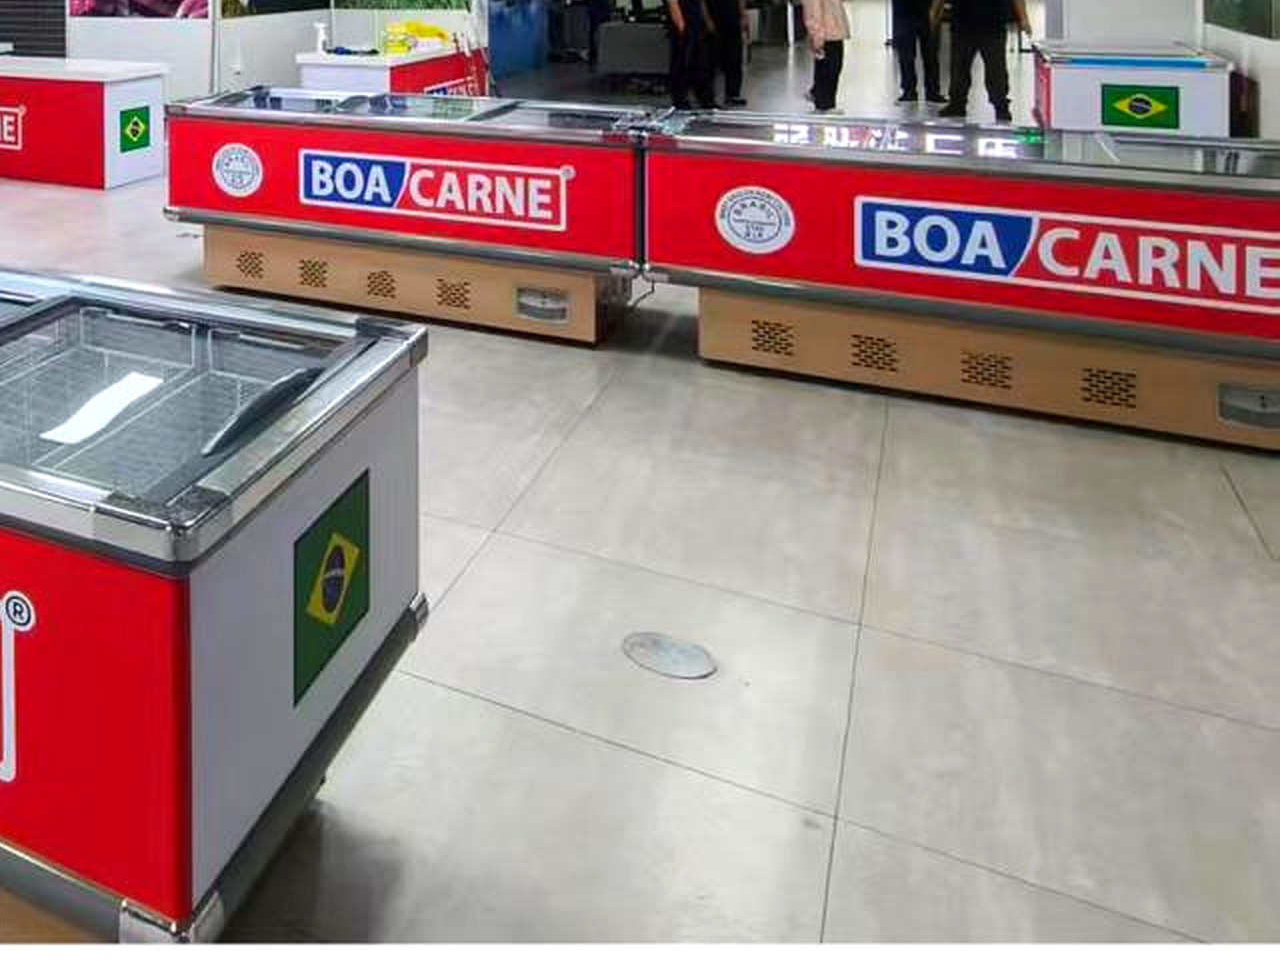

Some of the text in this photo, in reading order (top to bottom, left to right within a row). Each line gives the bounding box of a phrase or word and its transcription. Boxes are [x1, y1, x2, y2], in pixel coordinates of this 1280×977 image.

[310, 160, 393, 203] BOA
[408, 168, 553, 220] CARNE
[873, 210, 1280, 299] BOA CARNE
